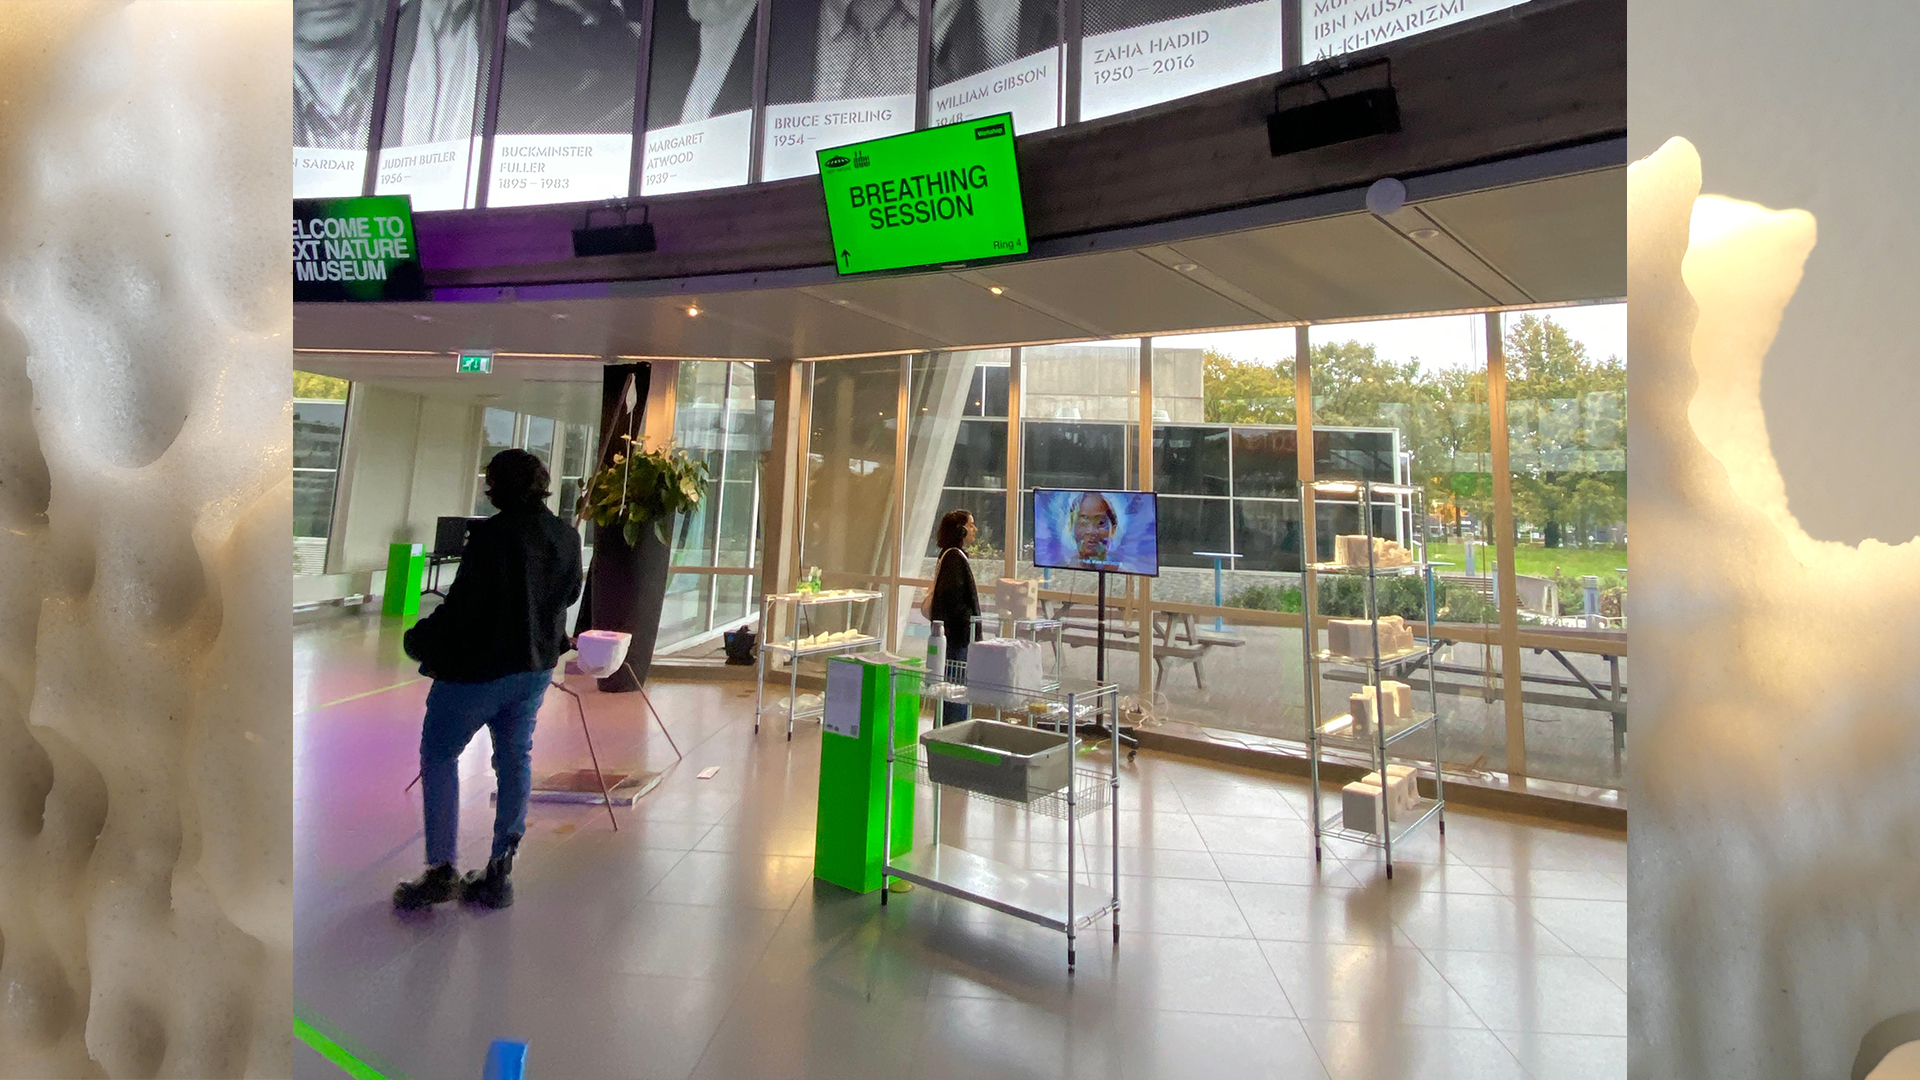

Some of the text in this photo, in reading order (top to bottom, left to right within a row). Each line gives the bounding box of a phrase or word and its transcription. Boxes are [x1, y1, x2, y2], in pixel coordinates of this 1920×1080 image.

[1315, 15, 1346, 40] IBN
[1094, 30, 1209, 64] ZAHA HADID
[1094, 65, 1133, 84] 1950
[1153, 54, 1195, 74] 2016
[937, 65, 1047, 112] WILLIAM GIBSON
[775, 109, 892, 129] BRUCE STERLING
[502, 146, 593, 157] BUCKMINSTER
[648, 132, 704, 154] MARGARET
[302, 158, 355, 171] SARDAR
[382, 151, 456, 170] JUDITH BUTLER
[500, 162, 545, 173] FULLER
[647, 151, 694, 170] ATWOOD
[499, 178, 527, 189] 1895
[541, 178, 570, 189] 1983
[849, 165, 988, 208] BREATHING
[868, 194, 974, 230] SESSION
[374, 216, 405, 237] TO
[324, 238, 410, 260] NATURE
[993, 238, 1022, 250] Ring 4
[296, 260, 387, 282] MUSEUM
